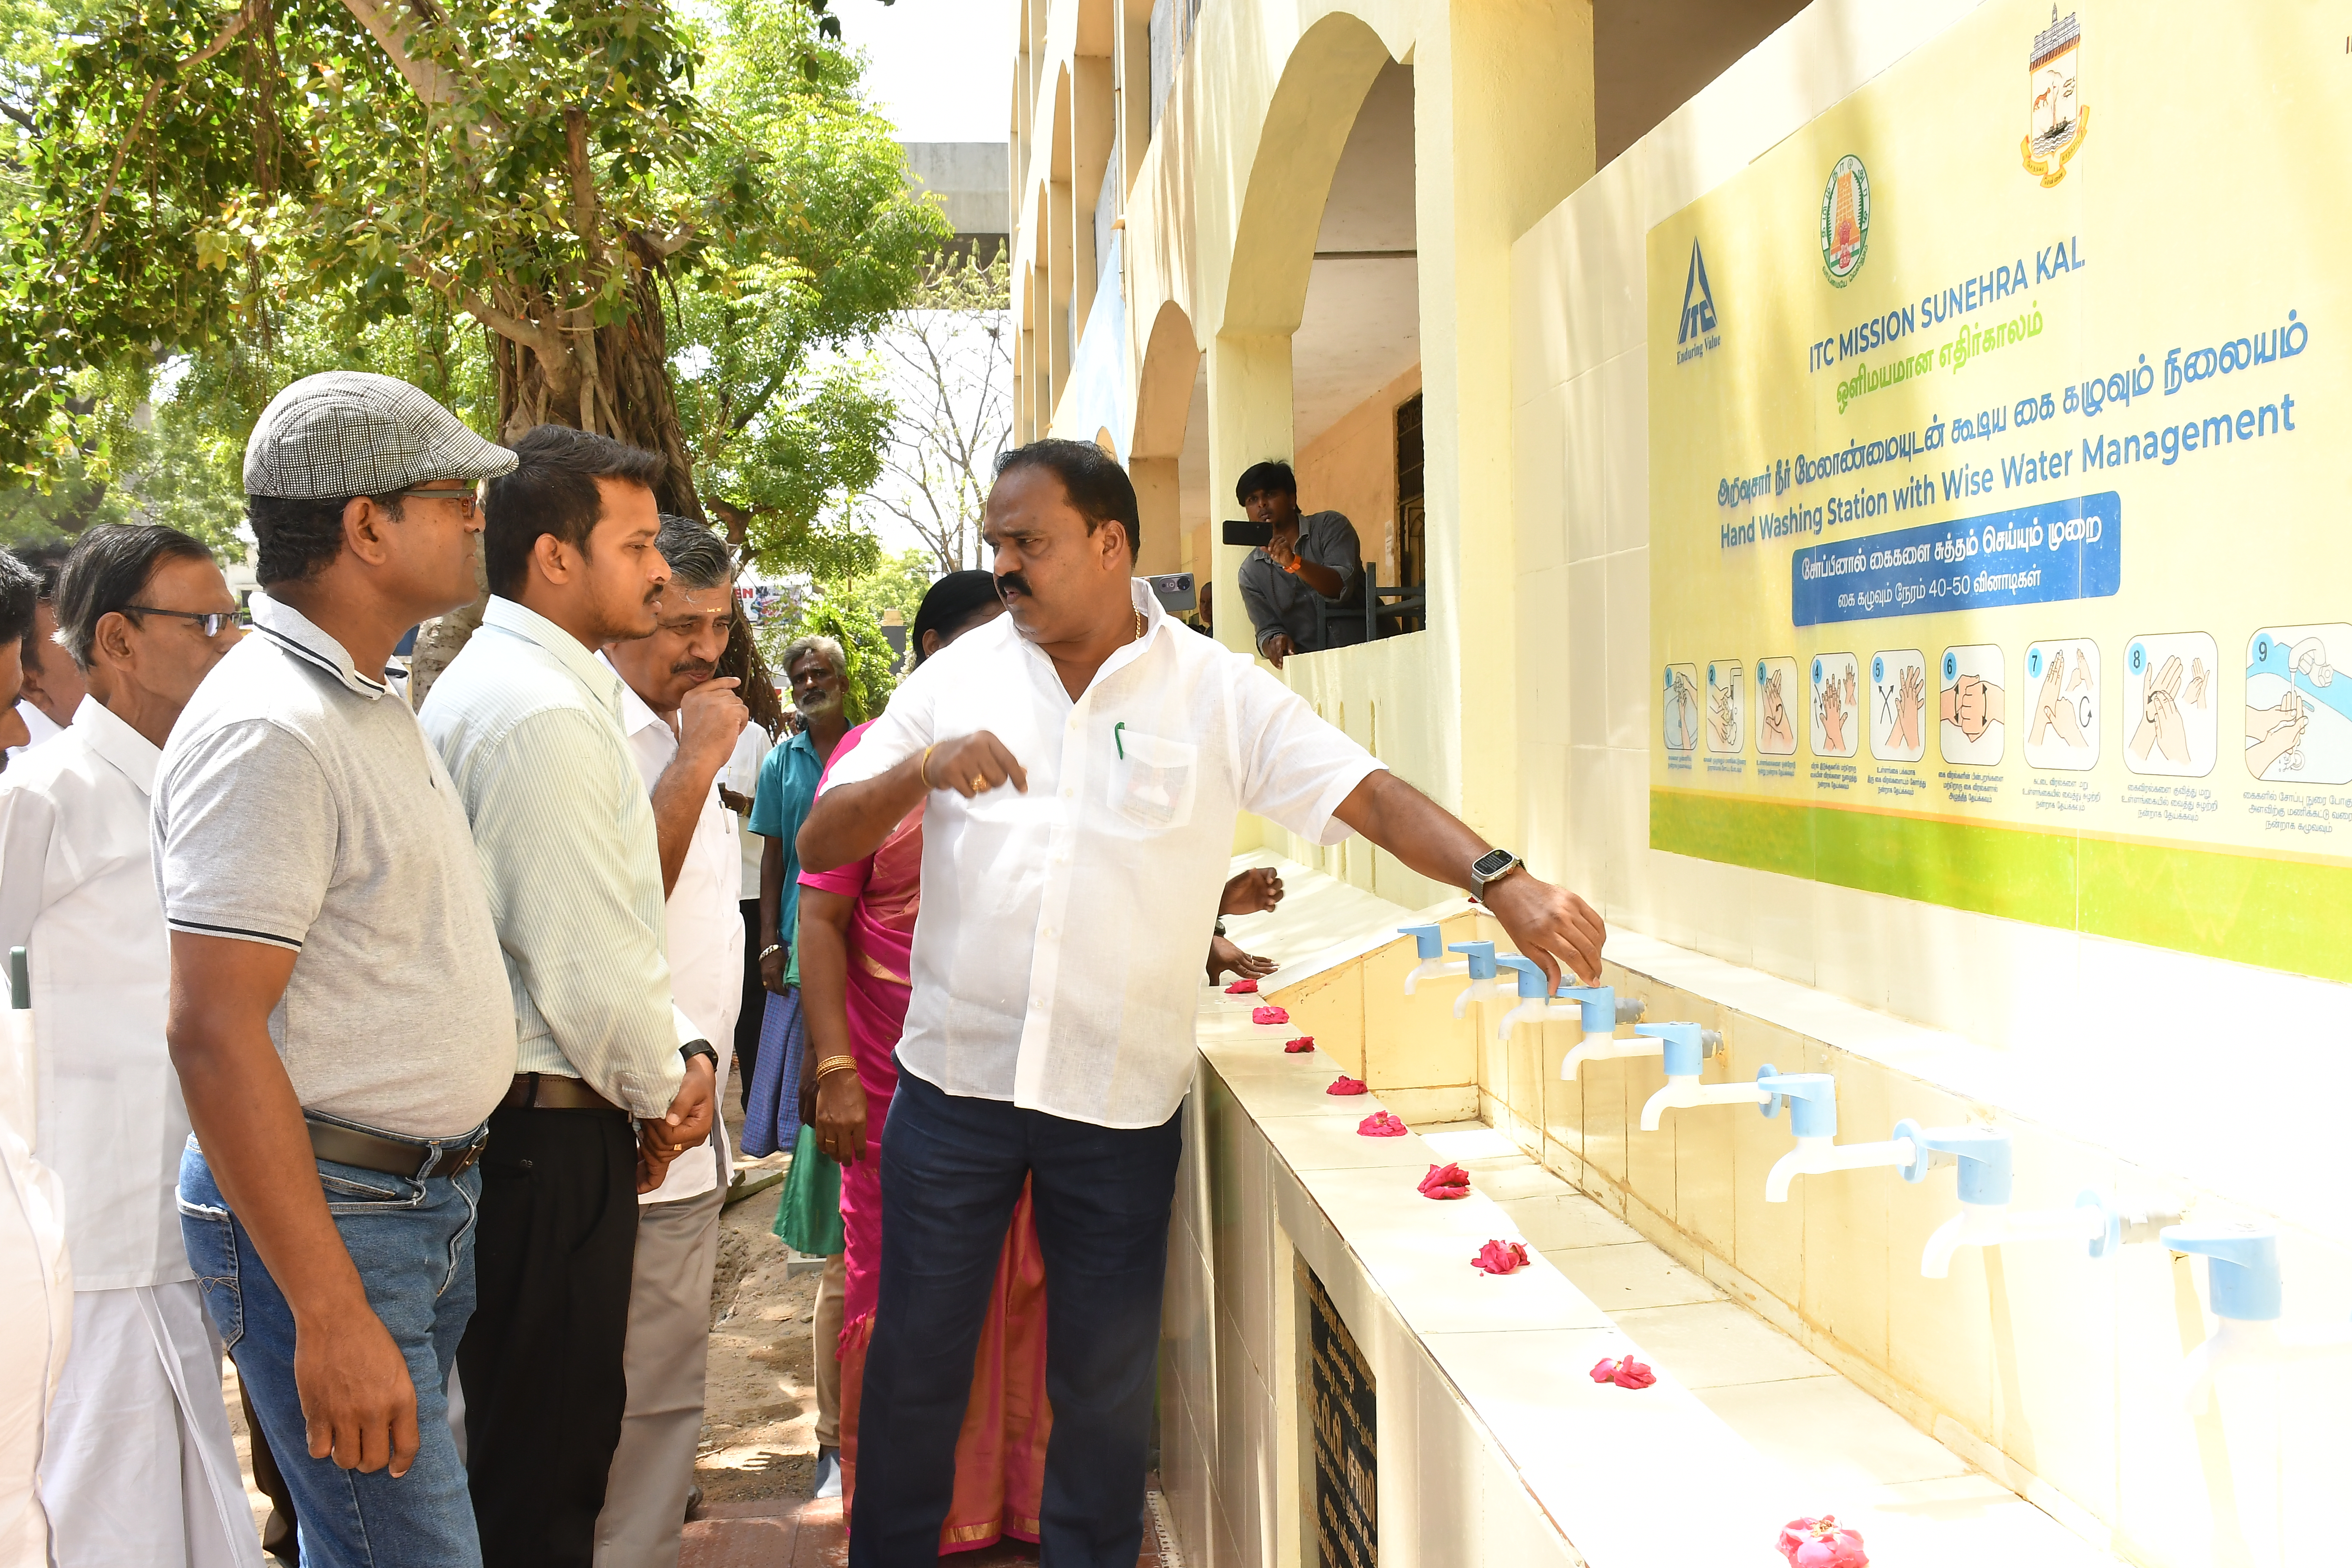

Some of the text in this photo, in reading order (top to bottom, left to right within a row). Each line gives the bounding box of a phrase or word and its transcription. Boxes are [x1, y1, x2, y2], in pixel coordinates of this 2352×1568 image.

[1809, 235, 2085, 373] ITC MISSION SUNEHRA KAL
[1679, 299, 1717, 345] ITC
[1677, 335, 1721, 365] Enduring Value
[1837, 300, 2043, 415] ஒளிமயமான எதிர்காலம்
[1718, 309, 2308, 508] அறிவுசார் நீர் மேலாண்மையுடன் கூடிய கை கழுவும் நிலையம்
[1720, 393, 2295, 549] Hand Washing Station with Wise Water Management
[1802, 514, 2102, 580] சோப்பினால் கைகளை சுத்தம் செய்யும் முறை
[1837, 563, 2041, 611] கை கழுவும் நேரம் 40-50 வினாடிகள்
[2133, 650, 2140, 669] 8
[2259, 642, 2268, 662] 9
[1815, 665, 1819, 679] 4
[1876, 663, 1880, 673] 5
[1947, 659, 1952, 675] 6
[2032, 655, 2038, 672] 7
[1710, 670, 1713, 681] 2
[1759, 667, 1764, 680] 3
[2243, 790, 2277, 801] கைகளில்
[2278, 791, 2304, 806] சோப்பு
[2306, 795, 2327, 806] நுரை
[2248, 804, 2285, 817] அளவிற்கு
[2287, 806, 2330, 820] மணிக்கட்டு
[2265, 818, 2295, 832] நன்றாக
